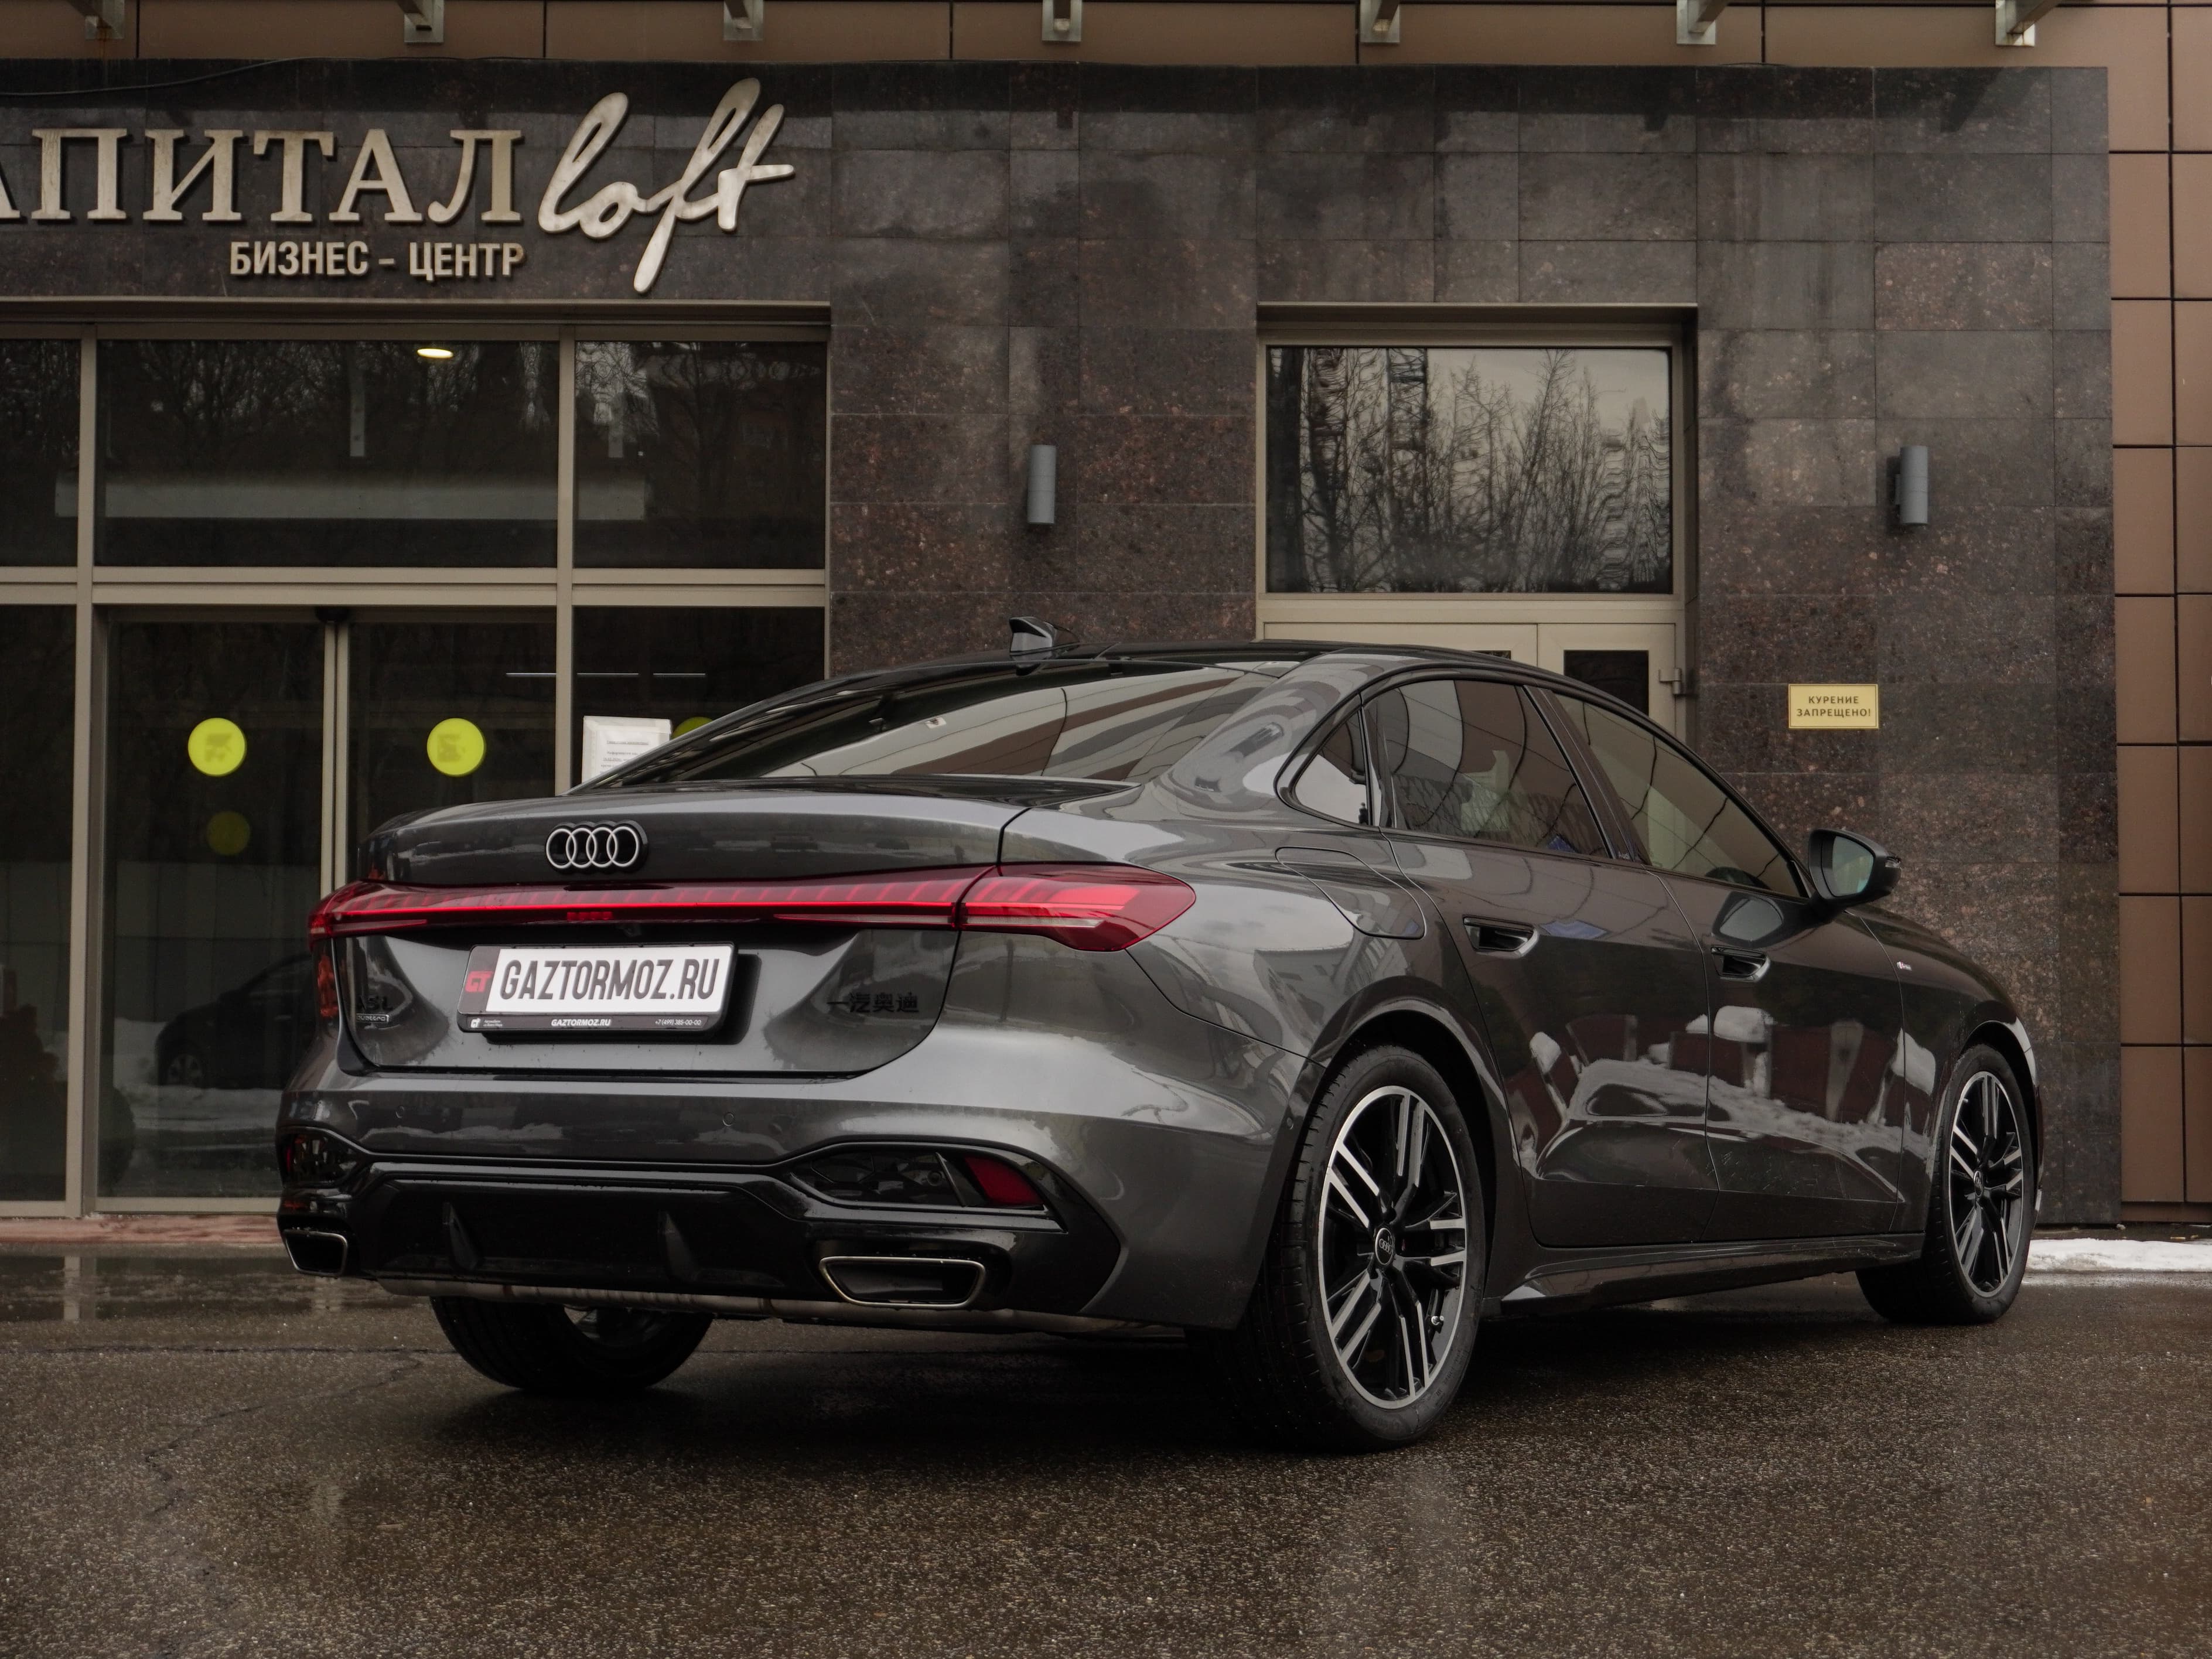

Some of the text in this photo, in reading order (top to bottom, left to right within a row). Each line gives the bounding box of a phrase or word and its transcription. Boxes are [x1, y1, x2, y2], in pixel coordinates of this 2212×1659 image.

[0, 128, 525, 224] ПИТАЛ
[537, 77, 796, 294] loft
[230, 241, 369, 277] БИЗНЕС
[408, 242, 525, 282] ЦЕНТР
[1797, 708, 1870, 718] ЗАПРЕЩЕНО!
[500, 958, 720, 1001] GAZTORMOZ.RU
[551, 1018, 612, 1027] GAZTORMOZ.RU
